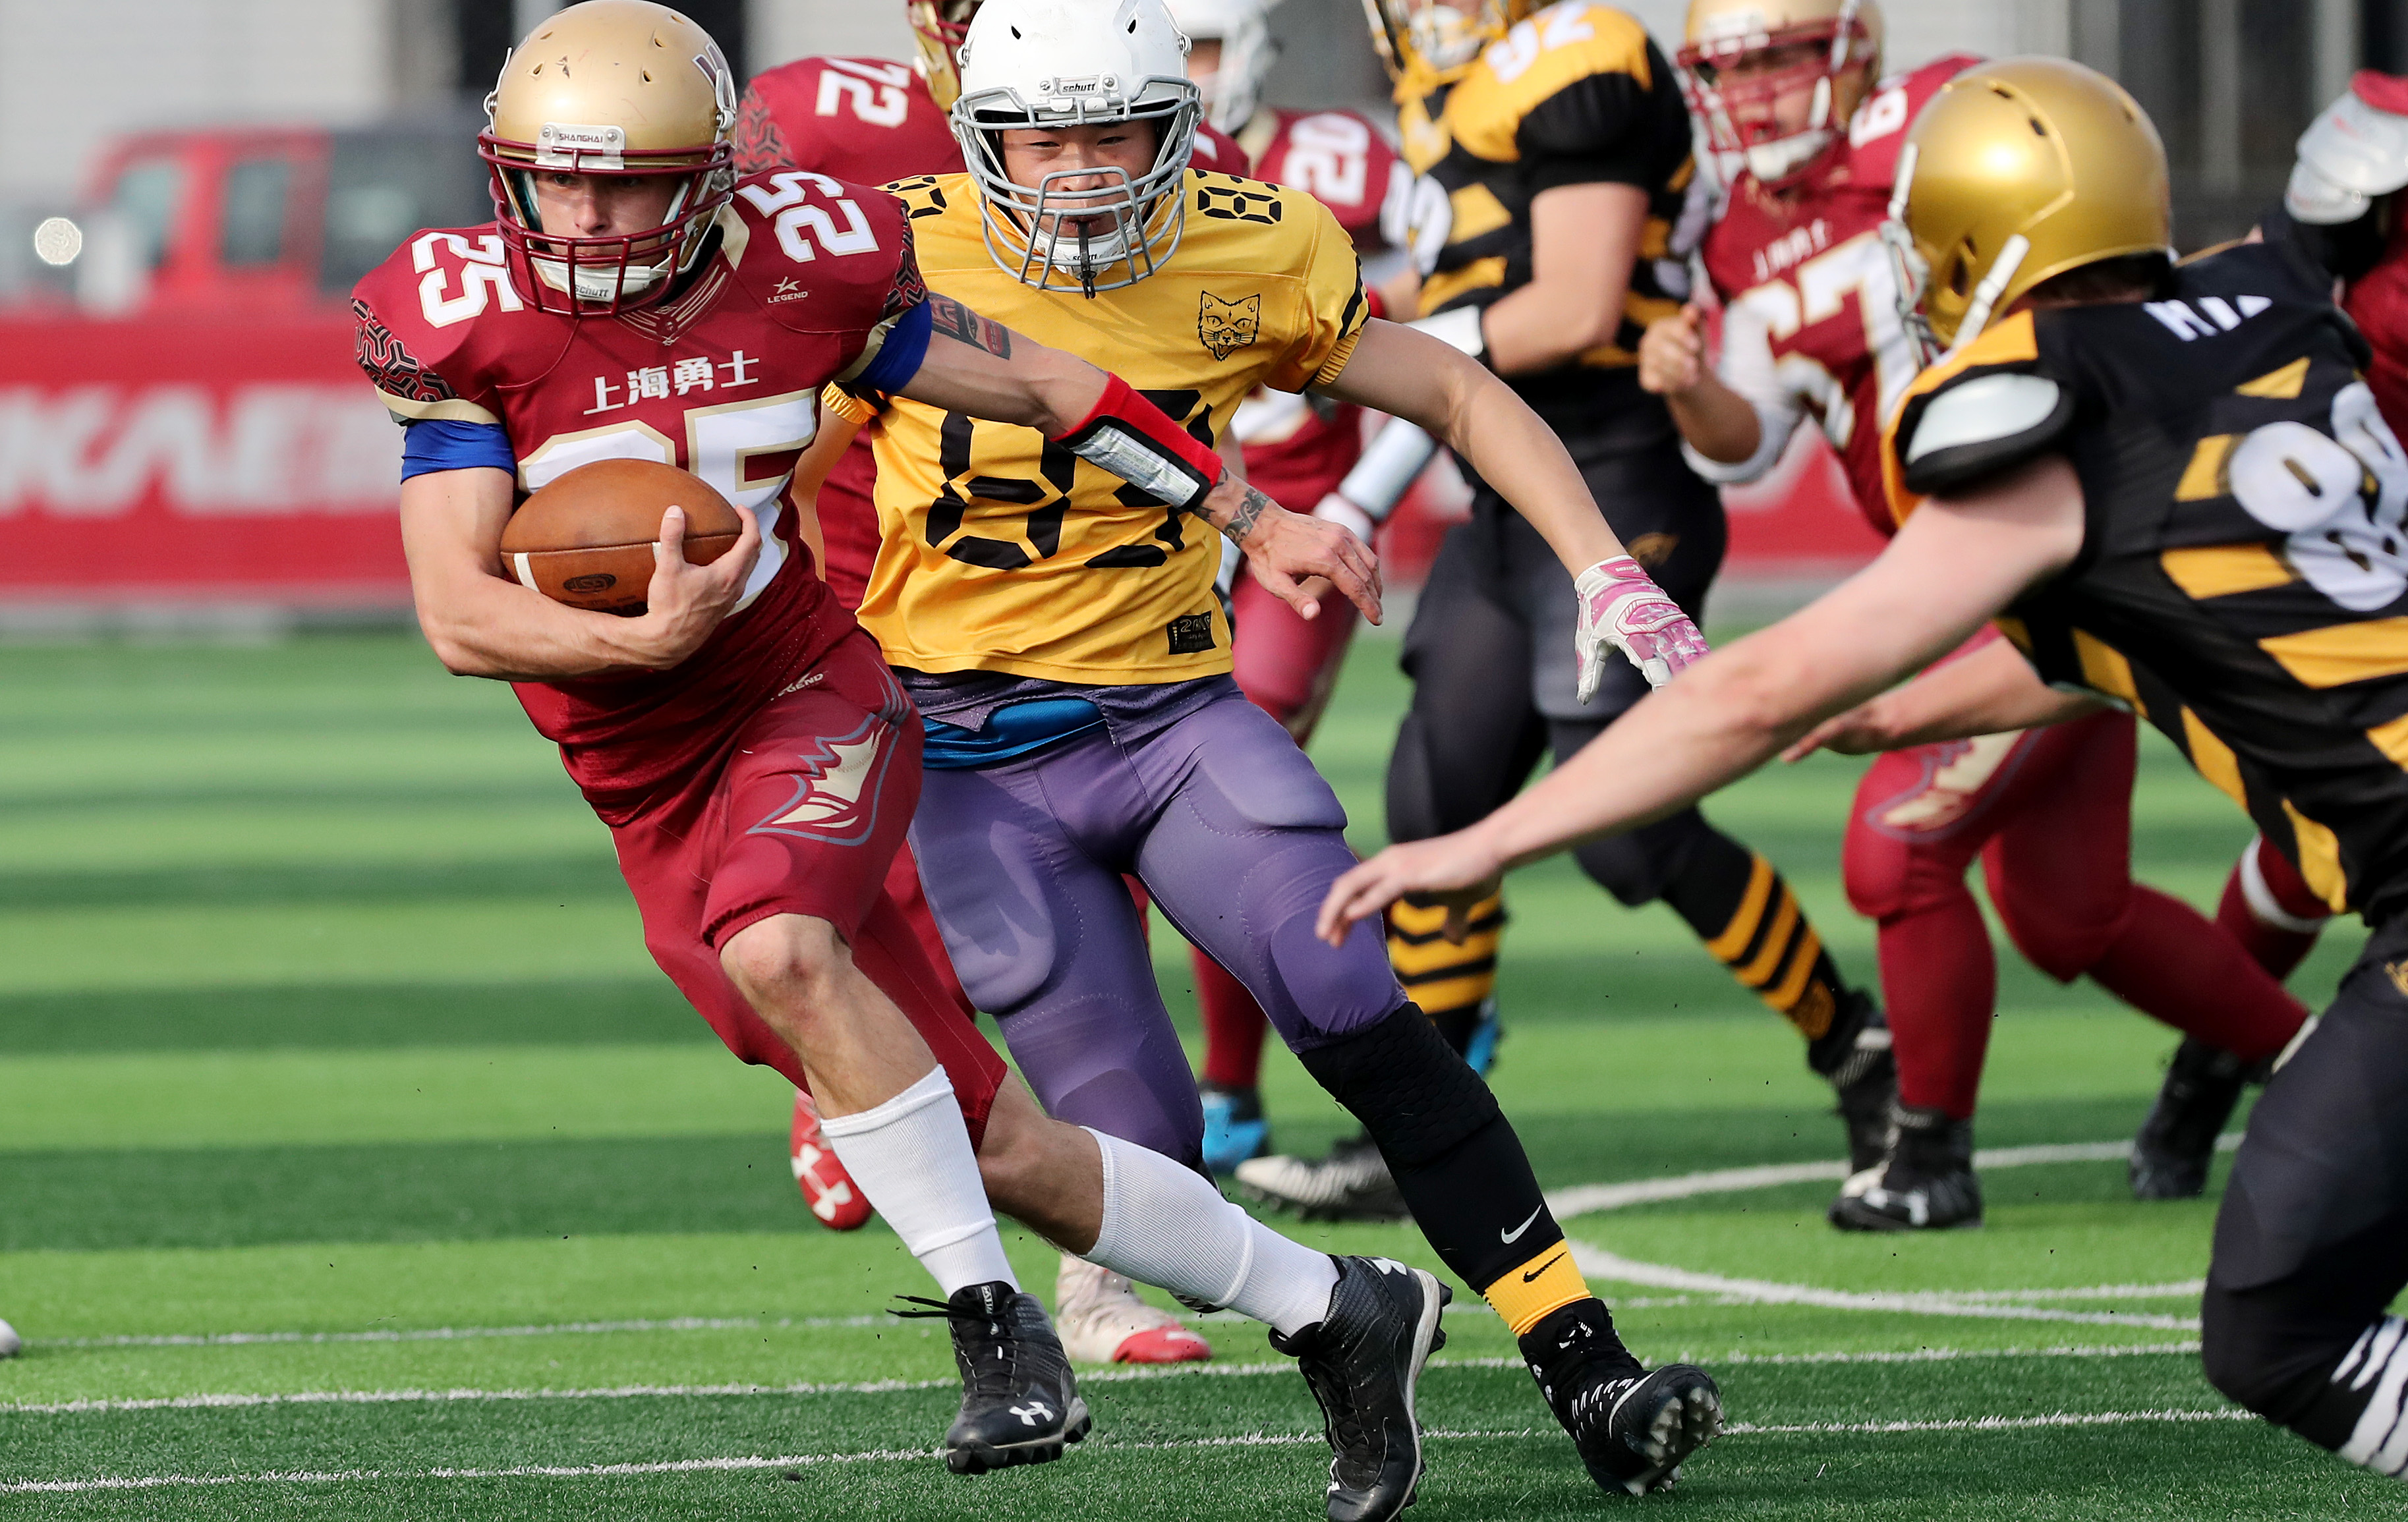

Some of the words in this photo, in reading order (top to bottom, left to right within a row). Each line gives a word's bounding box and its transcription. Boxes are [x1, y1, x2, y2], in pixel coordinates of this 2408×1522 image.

[815, 57, 912, 128] 72
[1062, 83, 1095, 92] schutt
[559, 133, 603, 143] SHANGHAI
[1280, 112, 1371, 207] 20
[735, 171, 880, 263] 25
[411, 232, 525, 329] 25
[767, 291, 809, 303] LEGEND
[583, 350, 760, 415] 上海勇士
